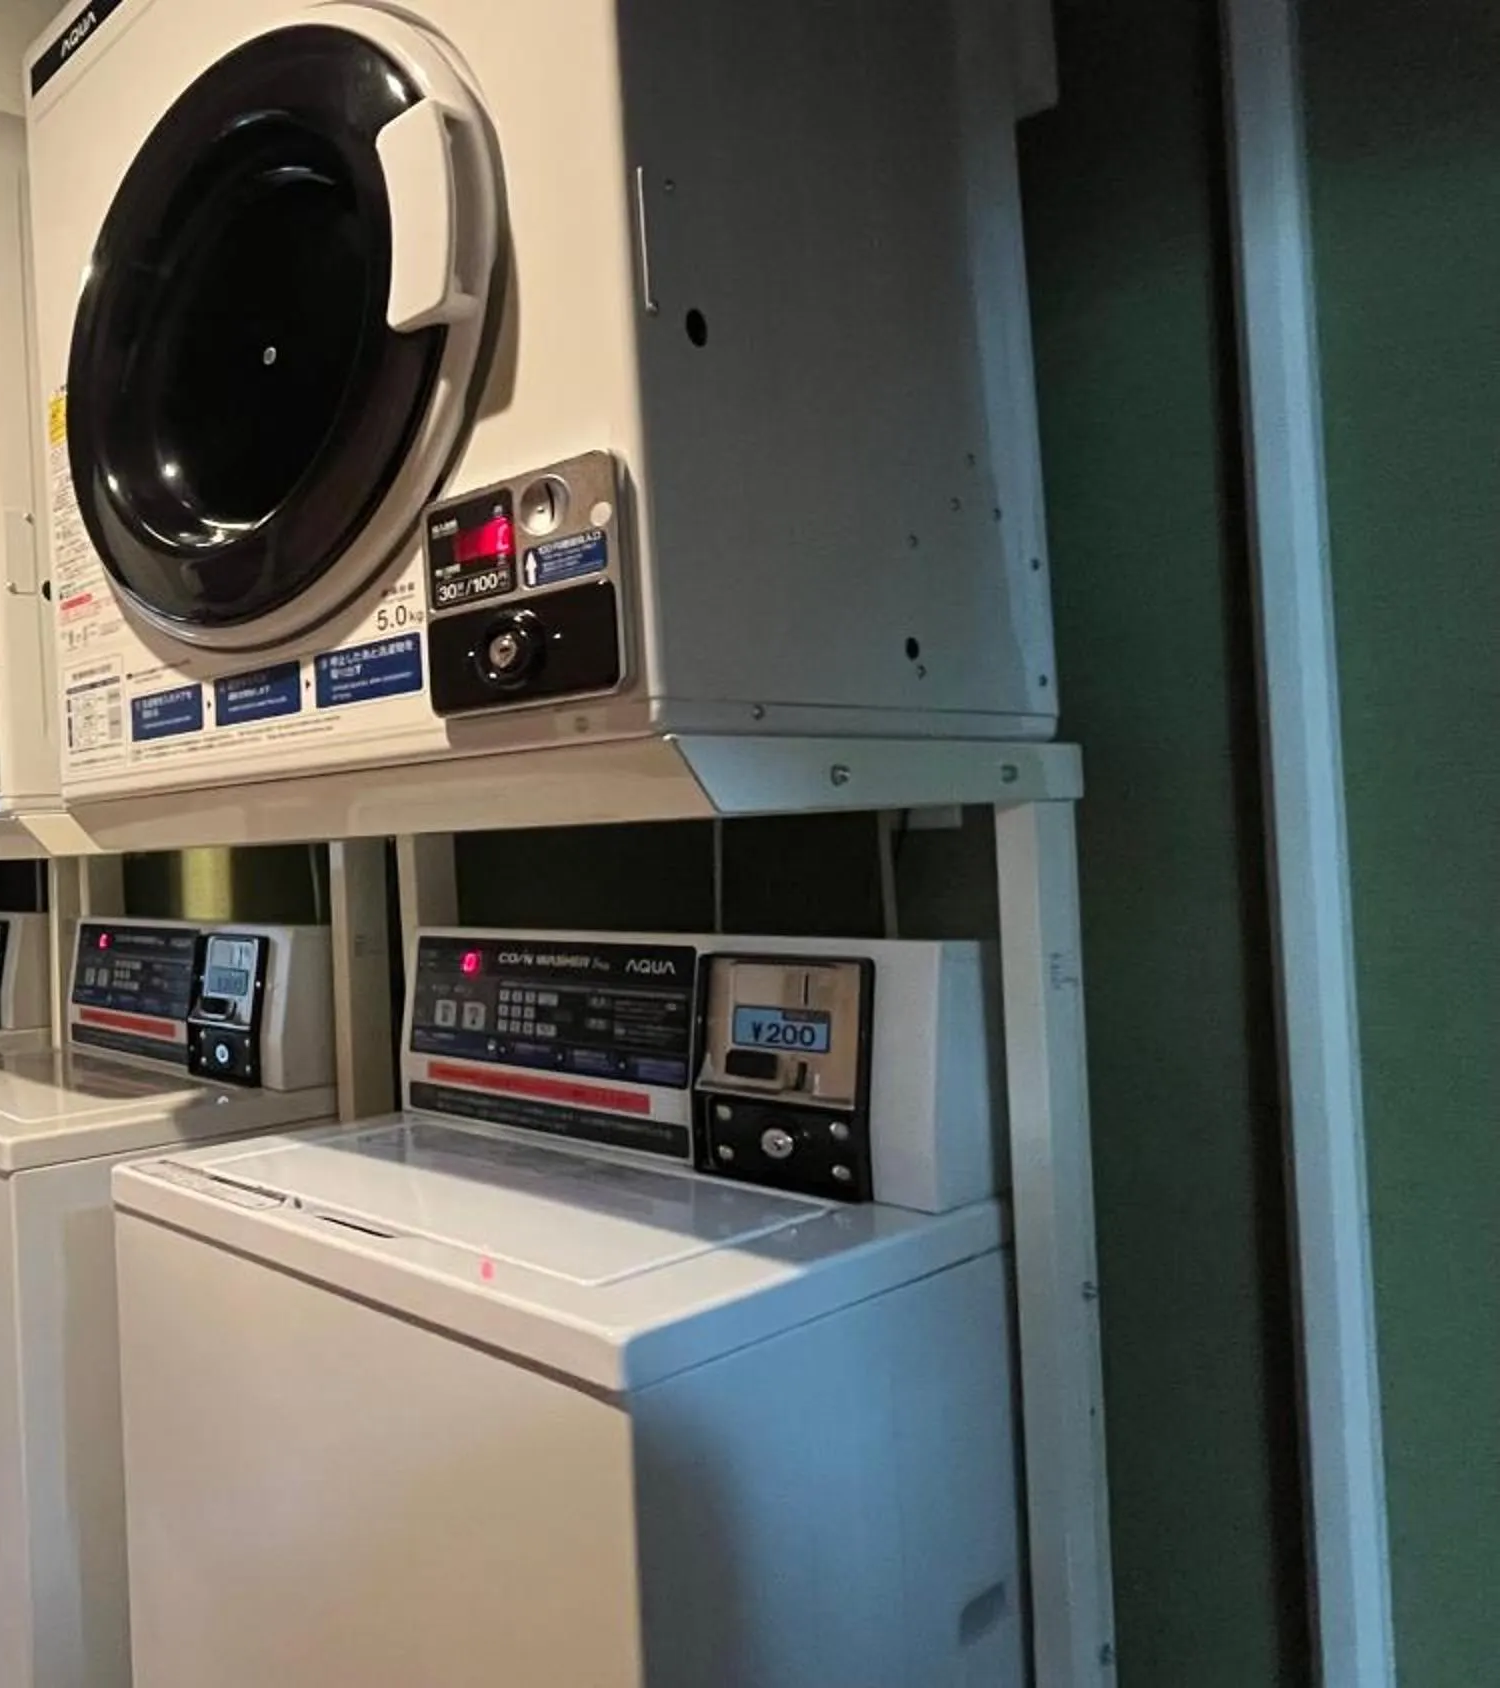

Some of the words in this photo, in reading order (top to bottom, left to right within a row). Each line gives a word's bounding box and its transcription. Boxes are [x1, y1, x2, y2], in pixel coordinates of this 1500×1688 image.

[60, 11, 97, 59] AQUA
[463, 951, 478, 973] 0
[625, 959, 676, 975] AQUA
[751, 1021, 816, 1047] ¥200
